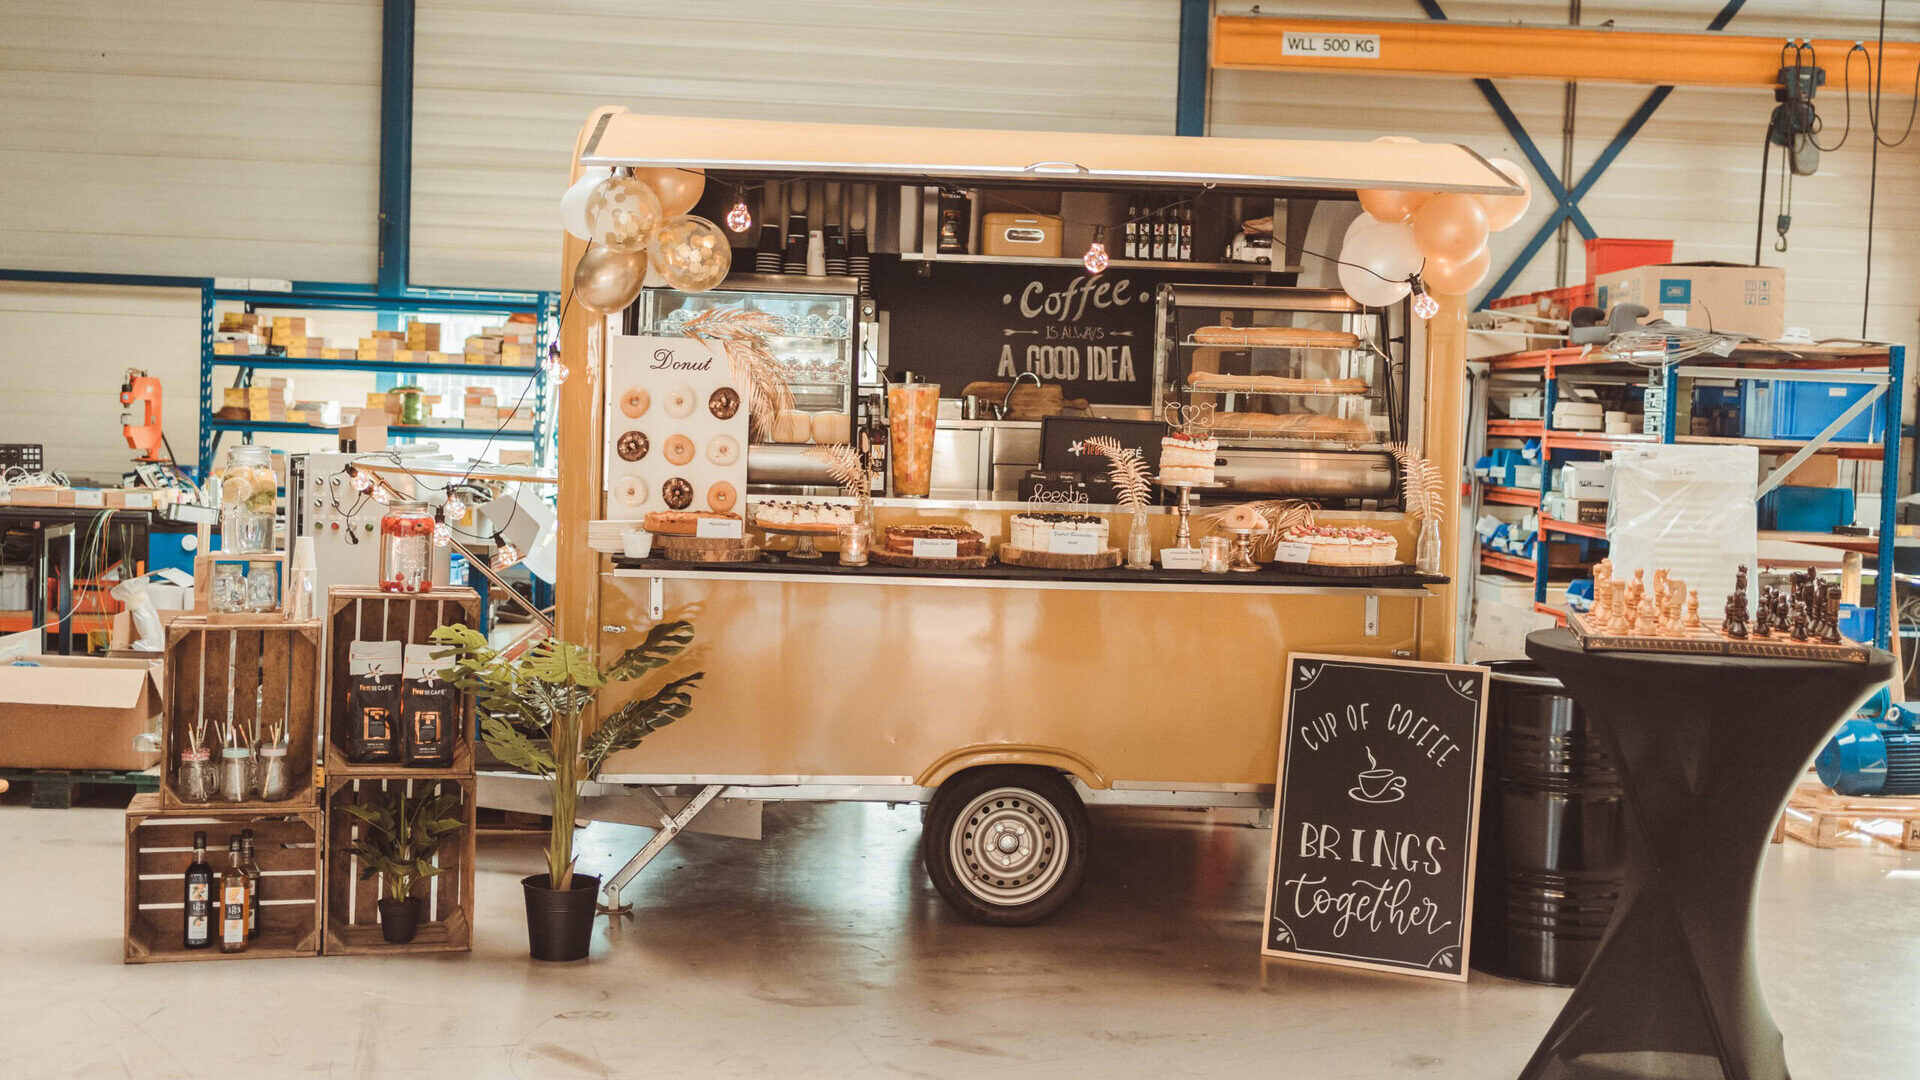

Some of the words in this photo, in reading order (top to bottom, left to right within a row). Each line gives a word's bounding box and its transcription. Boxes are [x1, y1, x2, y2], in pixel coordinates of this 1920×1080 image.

[1287, 37, 1316, 51] WLL
[1323, 38, 1350, 52] 500
[1355, 39, 1375, 53] KG
[1019, 274, 1132, 322] Coffee
[1046, 325, 1059, 340] IS
[1061, 325, 1105, 342] ALWAYS
[649, 348, 713, 371] Donut
[997, 344, 1017, 378] A
[1026, 344, 1080, 381] GOOD
[1087, 345, 1137, 382] IDEA
[1301, 712, 1337, 750] CUP
[1347, 703, 1370, 731] OF
[1387, 703, 1460, 767] COFFEE
[1299, 822, 1446, 875] BRINGS
[1285, 873, 1451, 938] together
